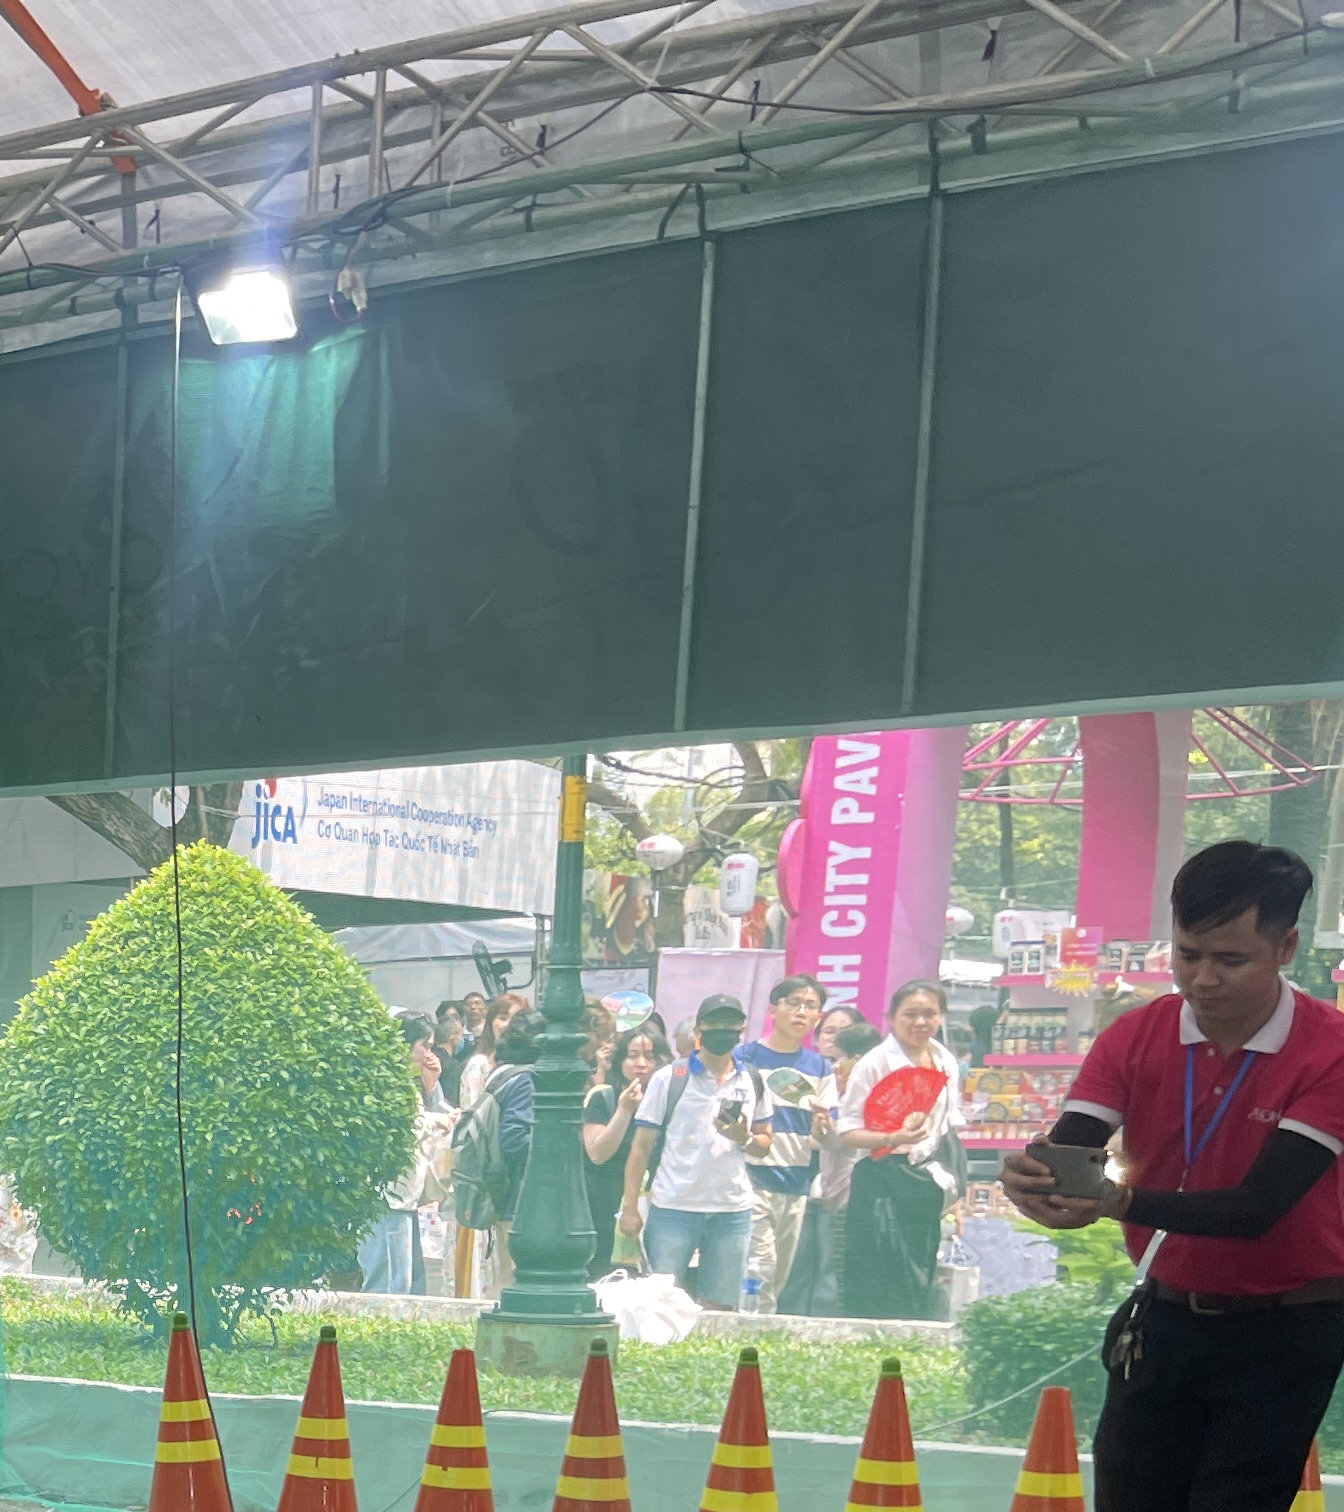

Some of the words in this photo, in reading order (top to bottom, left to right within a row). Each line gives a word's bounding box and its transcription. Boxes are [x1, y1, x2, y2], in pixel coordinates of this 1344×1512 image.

[317, 786, 348, 814] Japan
[349, 790, 409, 819] International
[411, 802, 465, 829] Cooperation
[466, 812, 498, 838] Agency
[830, 731, 882, 825] PAV
[334, 822, 359, 843] Quan
[820, 840, 873, 938] CITY
